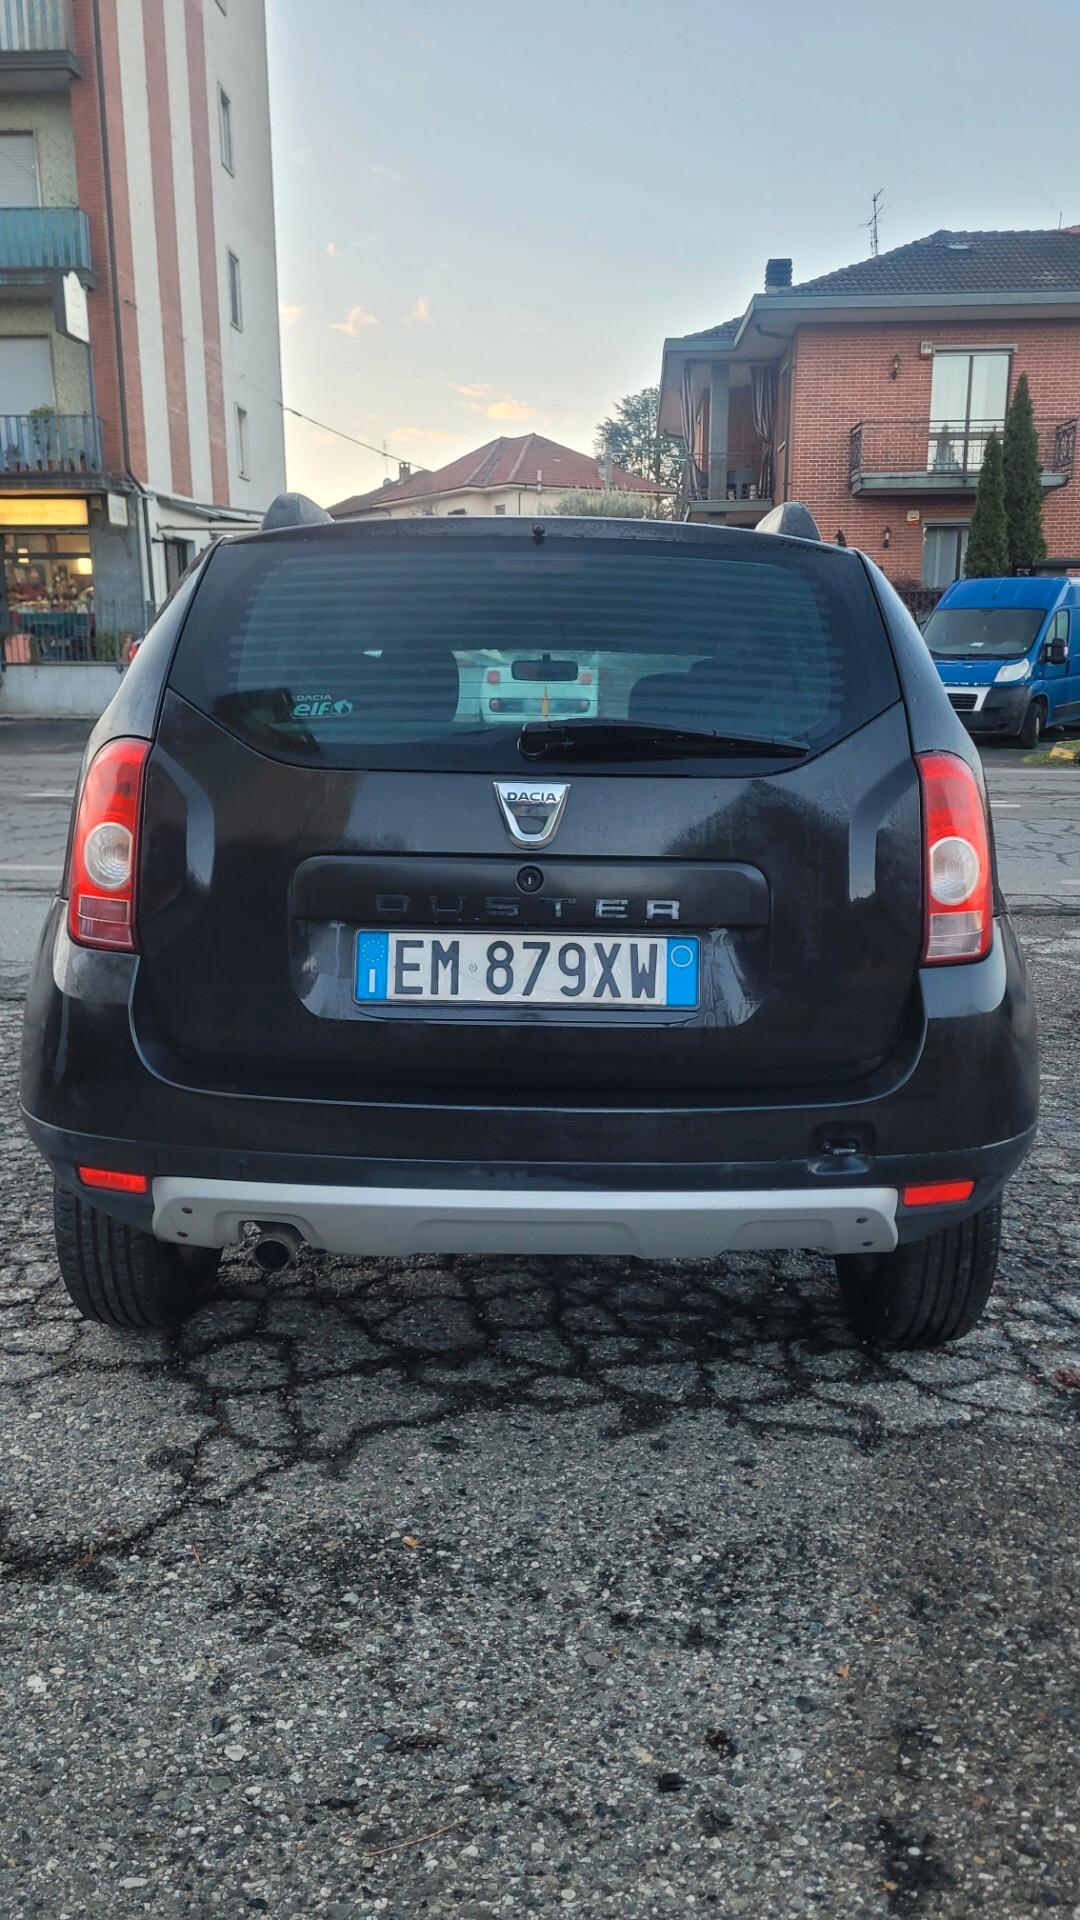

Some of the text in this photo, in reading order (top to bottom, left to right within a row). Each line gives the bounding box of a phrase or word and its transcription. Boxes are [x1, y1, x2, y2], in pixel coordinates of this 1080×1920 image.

[296, 694, 332, 702] DACIA
[507, 792, 557, 802] DACIA
[375, 894, 681, 920] DUSTER
[394, 939, 658, 999] EM 879XW
